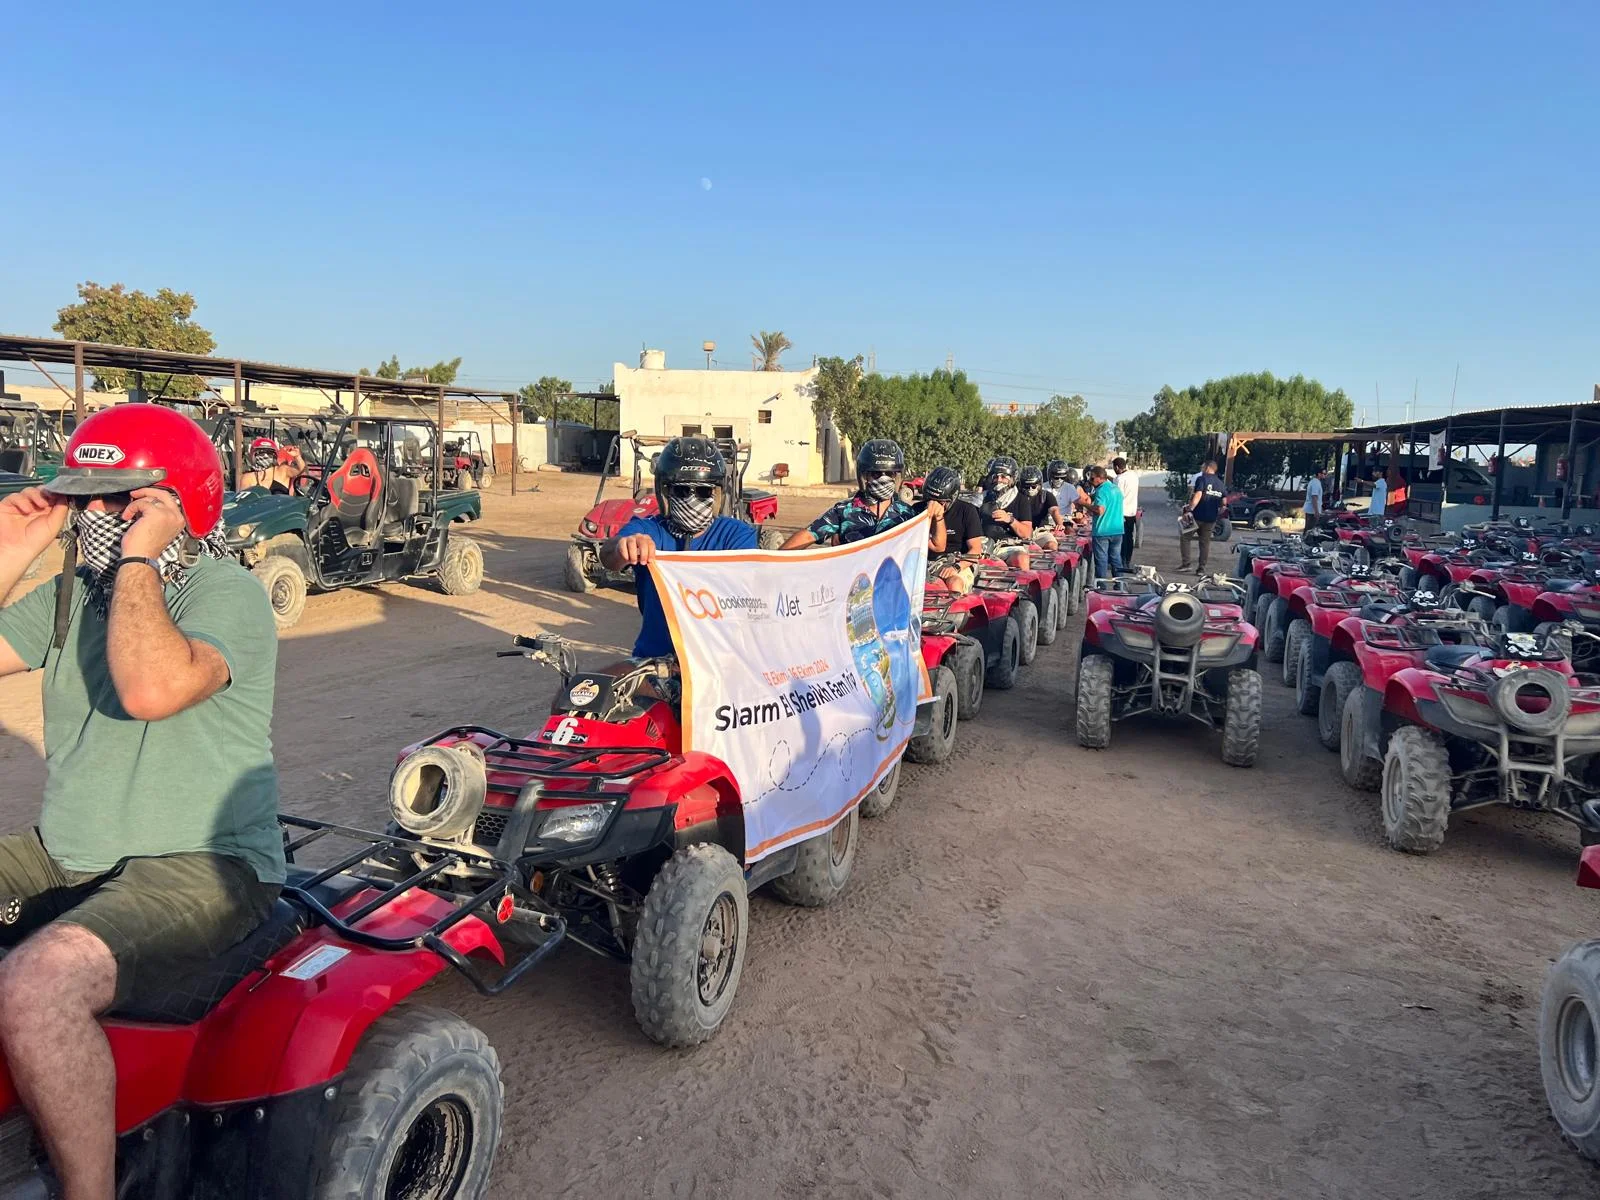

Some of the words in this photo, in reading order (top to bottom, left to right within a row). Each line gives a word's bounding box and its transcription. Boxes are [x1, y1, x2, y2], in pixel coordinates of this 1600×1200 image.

[78, 447, 116, 461] INDEX
[1166, 582, 1190, 593] 62
[776, 591, 802, 617] AJet
[779, 693, 796, 718] El
[790, 683, 831, 714] Sheikh
[826, 680, 850, 701] Fam
[543, 730, 588, 743] RON
[552, 717, 579, 746] 6
